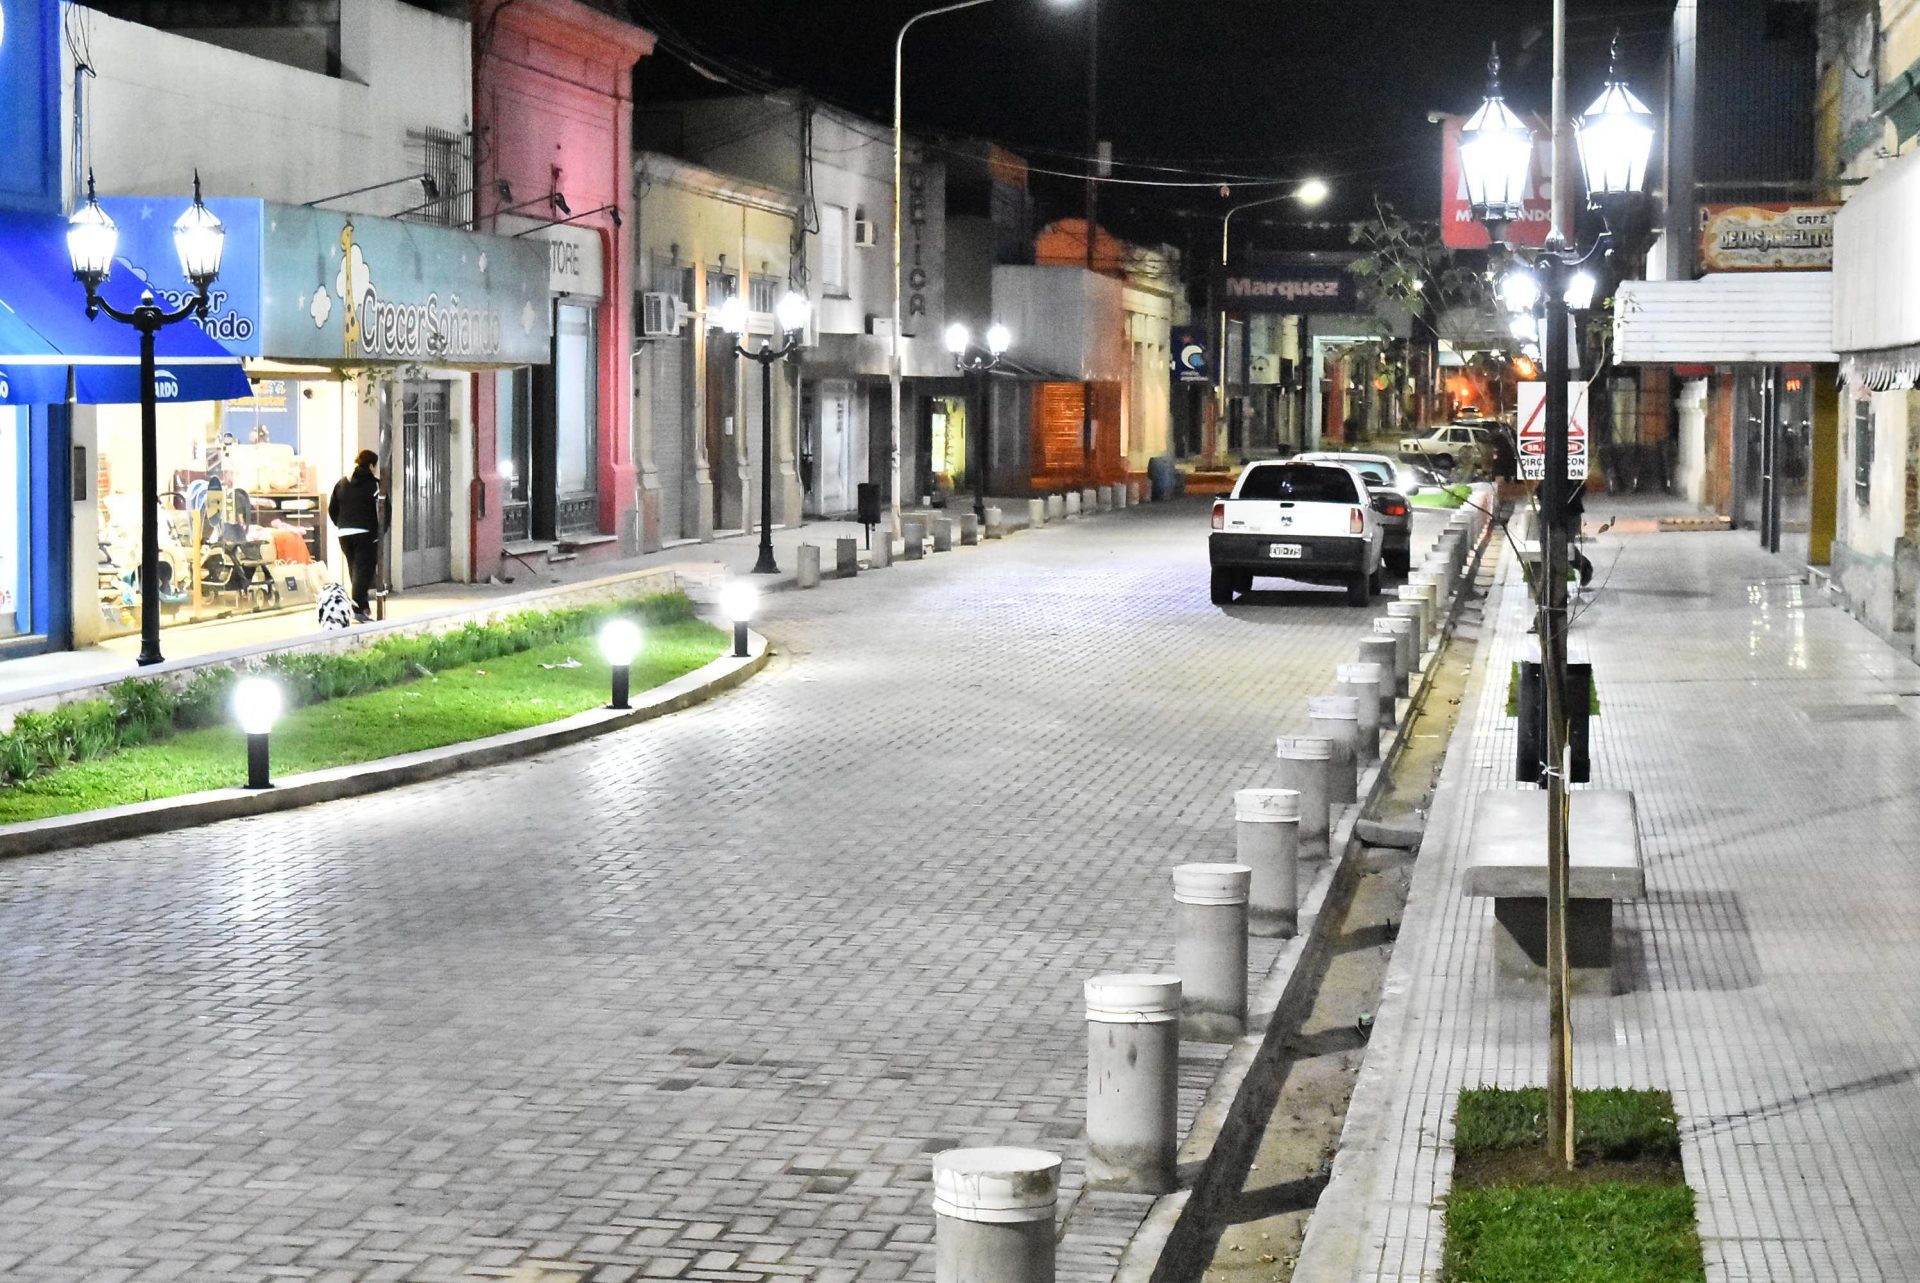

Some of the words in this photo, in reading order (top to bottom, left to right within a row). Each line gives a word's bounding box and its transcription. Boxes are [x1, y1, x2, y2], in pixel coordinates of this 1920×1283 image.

[550, 240, 580, 276] TORE
[1225, 277, 1339, 300] Marquez
[154, 381, 178, 398] ARDO
